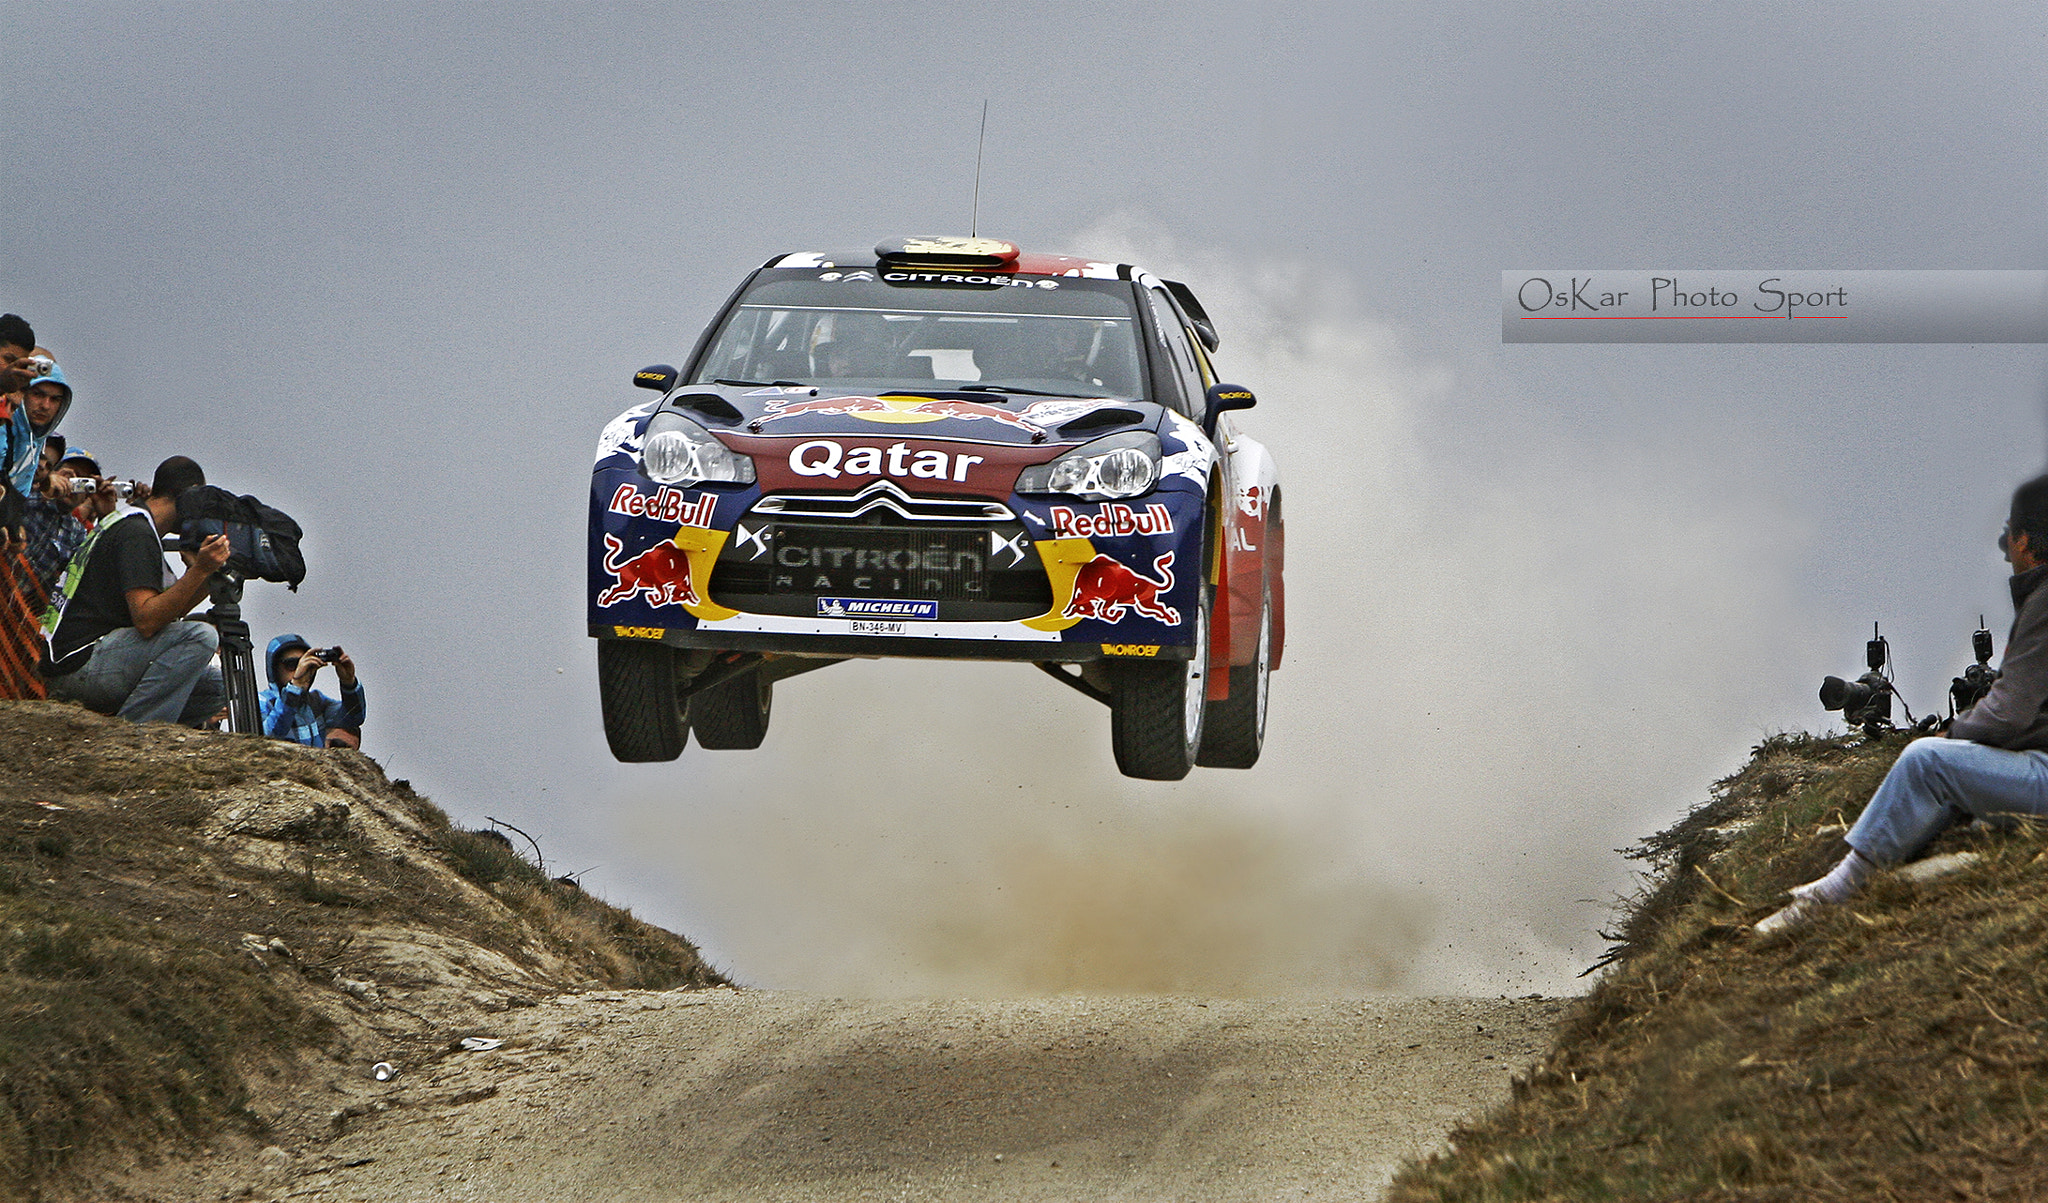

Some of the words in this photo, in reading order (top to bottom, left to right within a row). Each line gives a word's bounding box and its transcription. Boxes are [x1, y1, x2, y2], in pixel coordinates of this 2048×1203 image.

[788, 440, 985, 483] Qatar
[848, 601, 933, 615] MICHELIN
[613, 625, 666, 640] MONROE
[1100, 643, 1161, 657] MONROE
